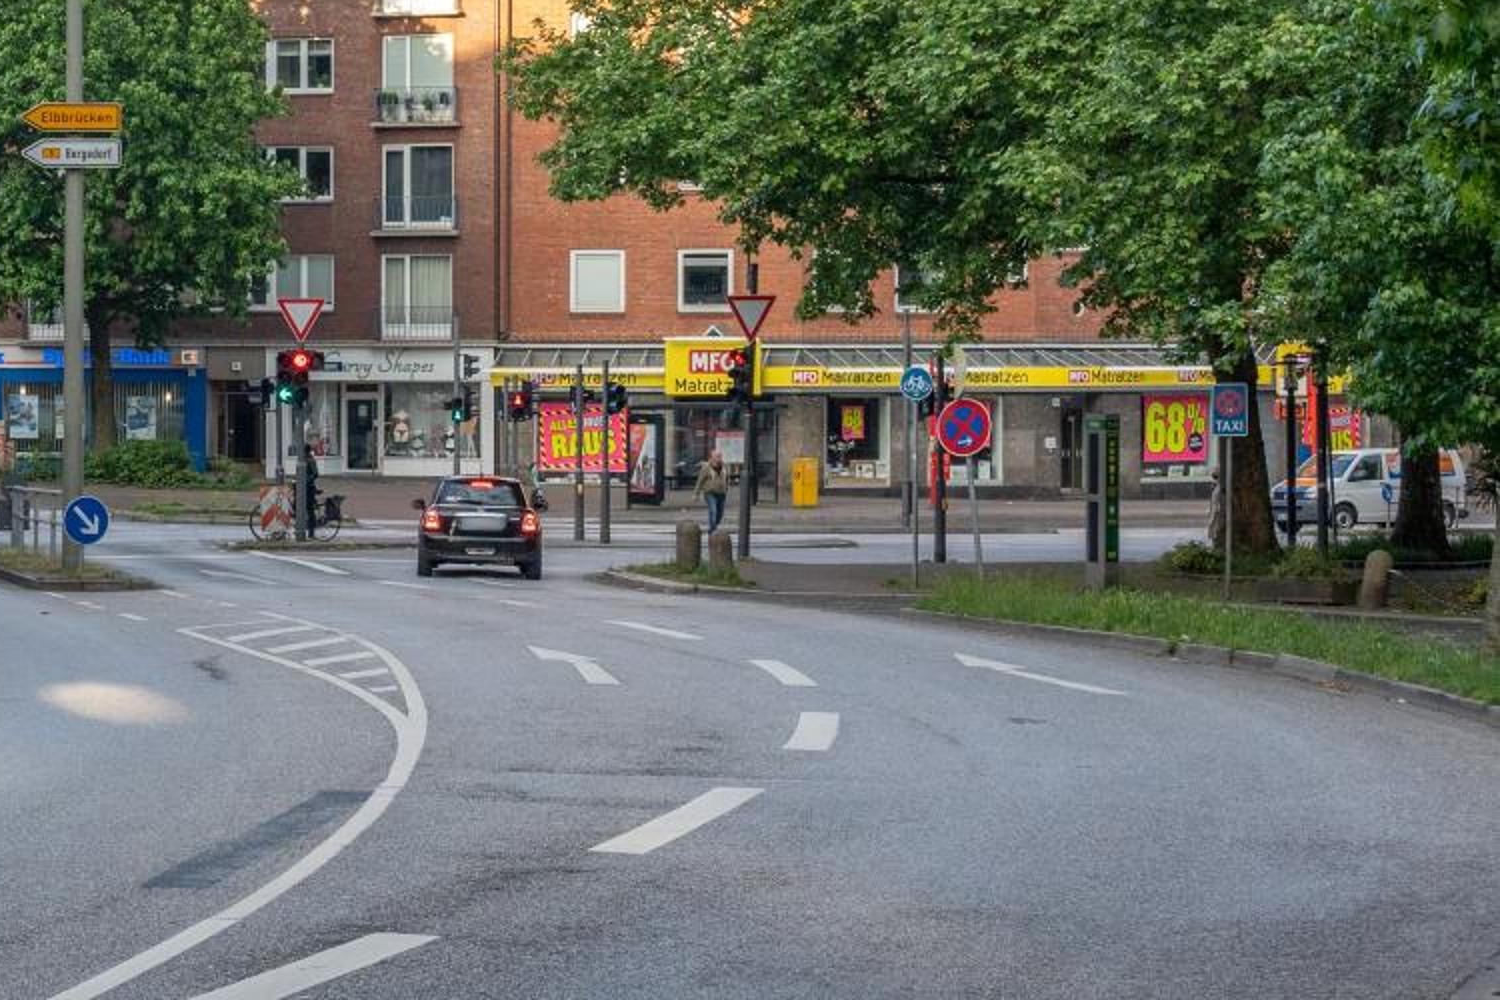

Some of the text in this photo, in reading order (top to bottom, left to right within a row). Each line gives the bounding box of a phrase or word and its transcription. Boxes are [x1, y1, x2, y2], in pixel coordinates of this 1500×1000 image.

[41, 110, 113, 123] Elbbrücken
[378, 349, 435, 378] Shapes
[822, 371, 892, 384] Matratzen
[1215, 420, 1245, 432] TAXI
